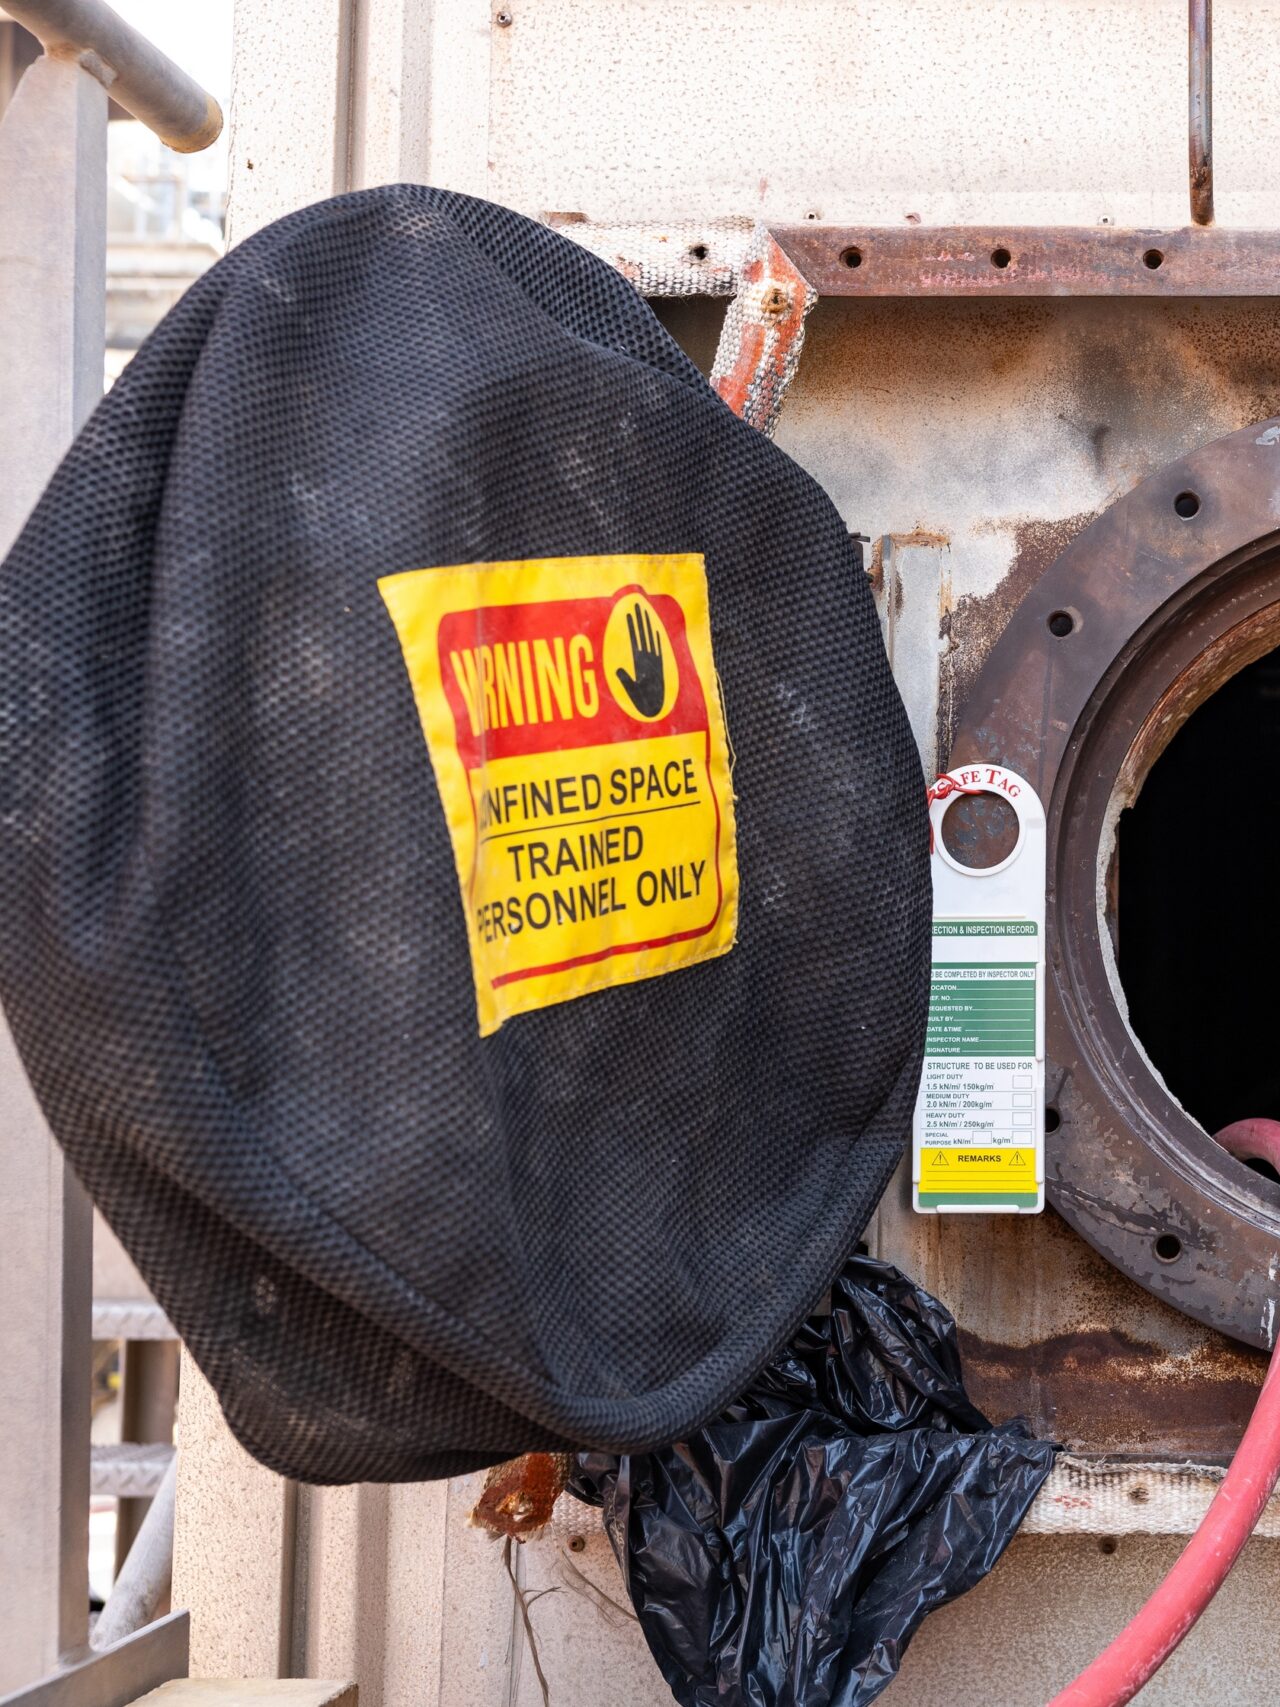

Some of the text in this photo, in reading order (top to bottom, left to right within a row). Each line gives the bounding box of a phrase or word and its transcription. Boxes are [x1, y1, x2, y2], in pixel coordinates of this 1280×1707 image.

[610, 758, 697, 805] SPACE
[507, 825, 643, 882] TRAINED
[636, 860, 706, 907] ONLY
[959, 925, 964, 935] &
[965, 925, 1005, 935] INSPECTION
[1006, 925, 1035, 935] RECORD
[935, 970, 943, 979] BE
[944, 970, 977, 979] COMPLETED
[978, 970, 986, 979] BY
[987, 970, 1019, 978] INSPECTOR
[1020, 969, 1034, 978] ONLY
[927, 1062, 1033, 1070] STRUCTURE TO BE USED FOR
[957, 1155, 1002, 1163] REMARKS
